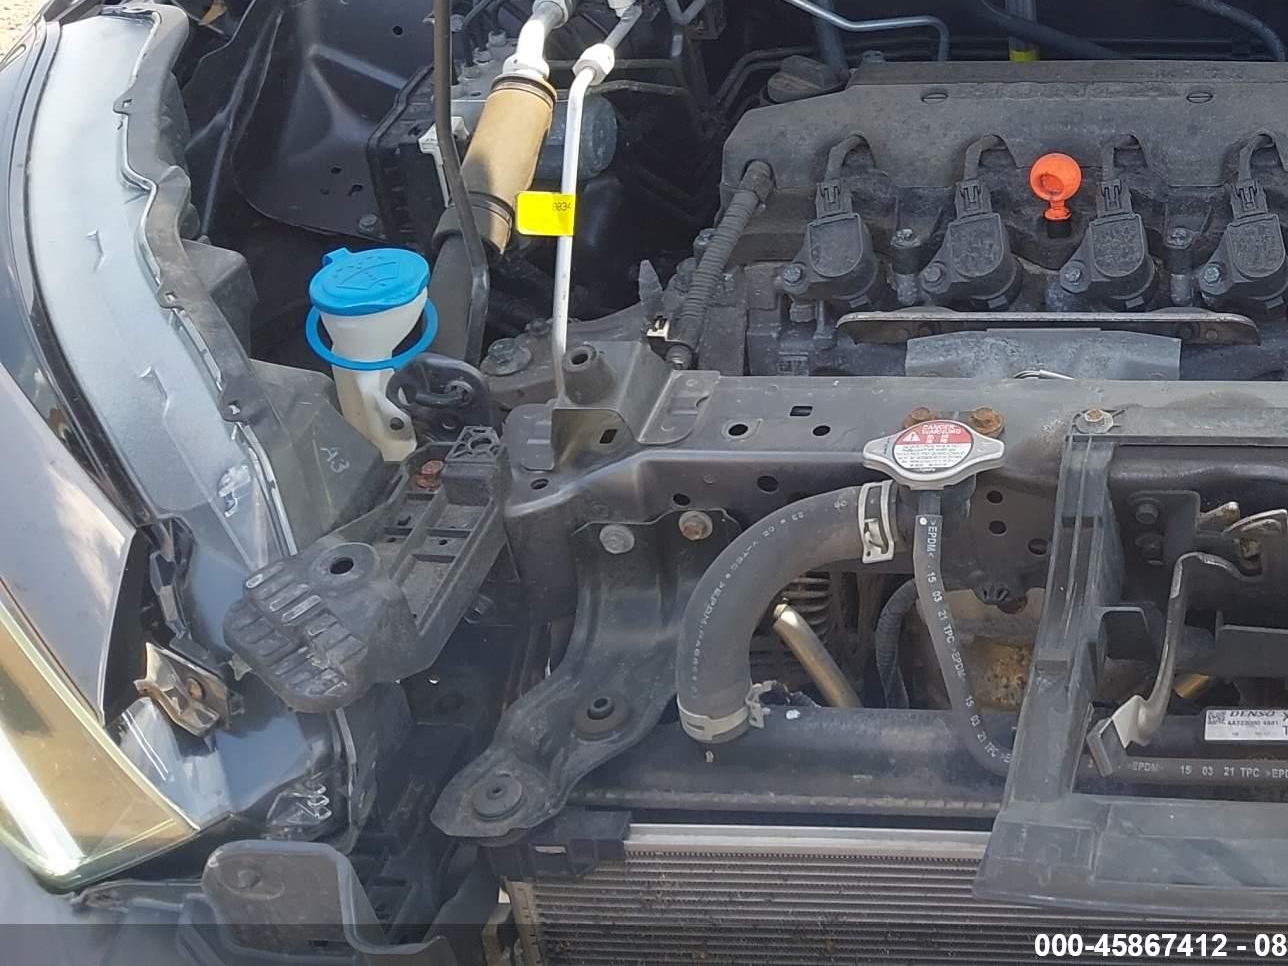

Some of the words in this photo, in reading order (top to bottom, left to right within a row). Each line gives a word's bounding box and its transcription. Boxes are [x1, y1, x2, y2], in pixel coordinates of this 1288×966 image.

[320, 446, 350, 474] A3
[926, 571, 937, 584] 15
[931, 590, 943, 603] 03
[937, 609, 949, 622] 21
[942, 623, 955, 644] TPC
[1180, 765, 1192, 776] 15
[1201, 765, 1214, 777] 03
[1223, 766, 1235, 777] 21
[1240, 767, 1260, 778] TPC
